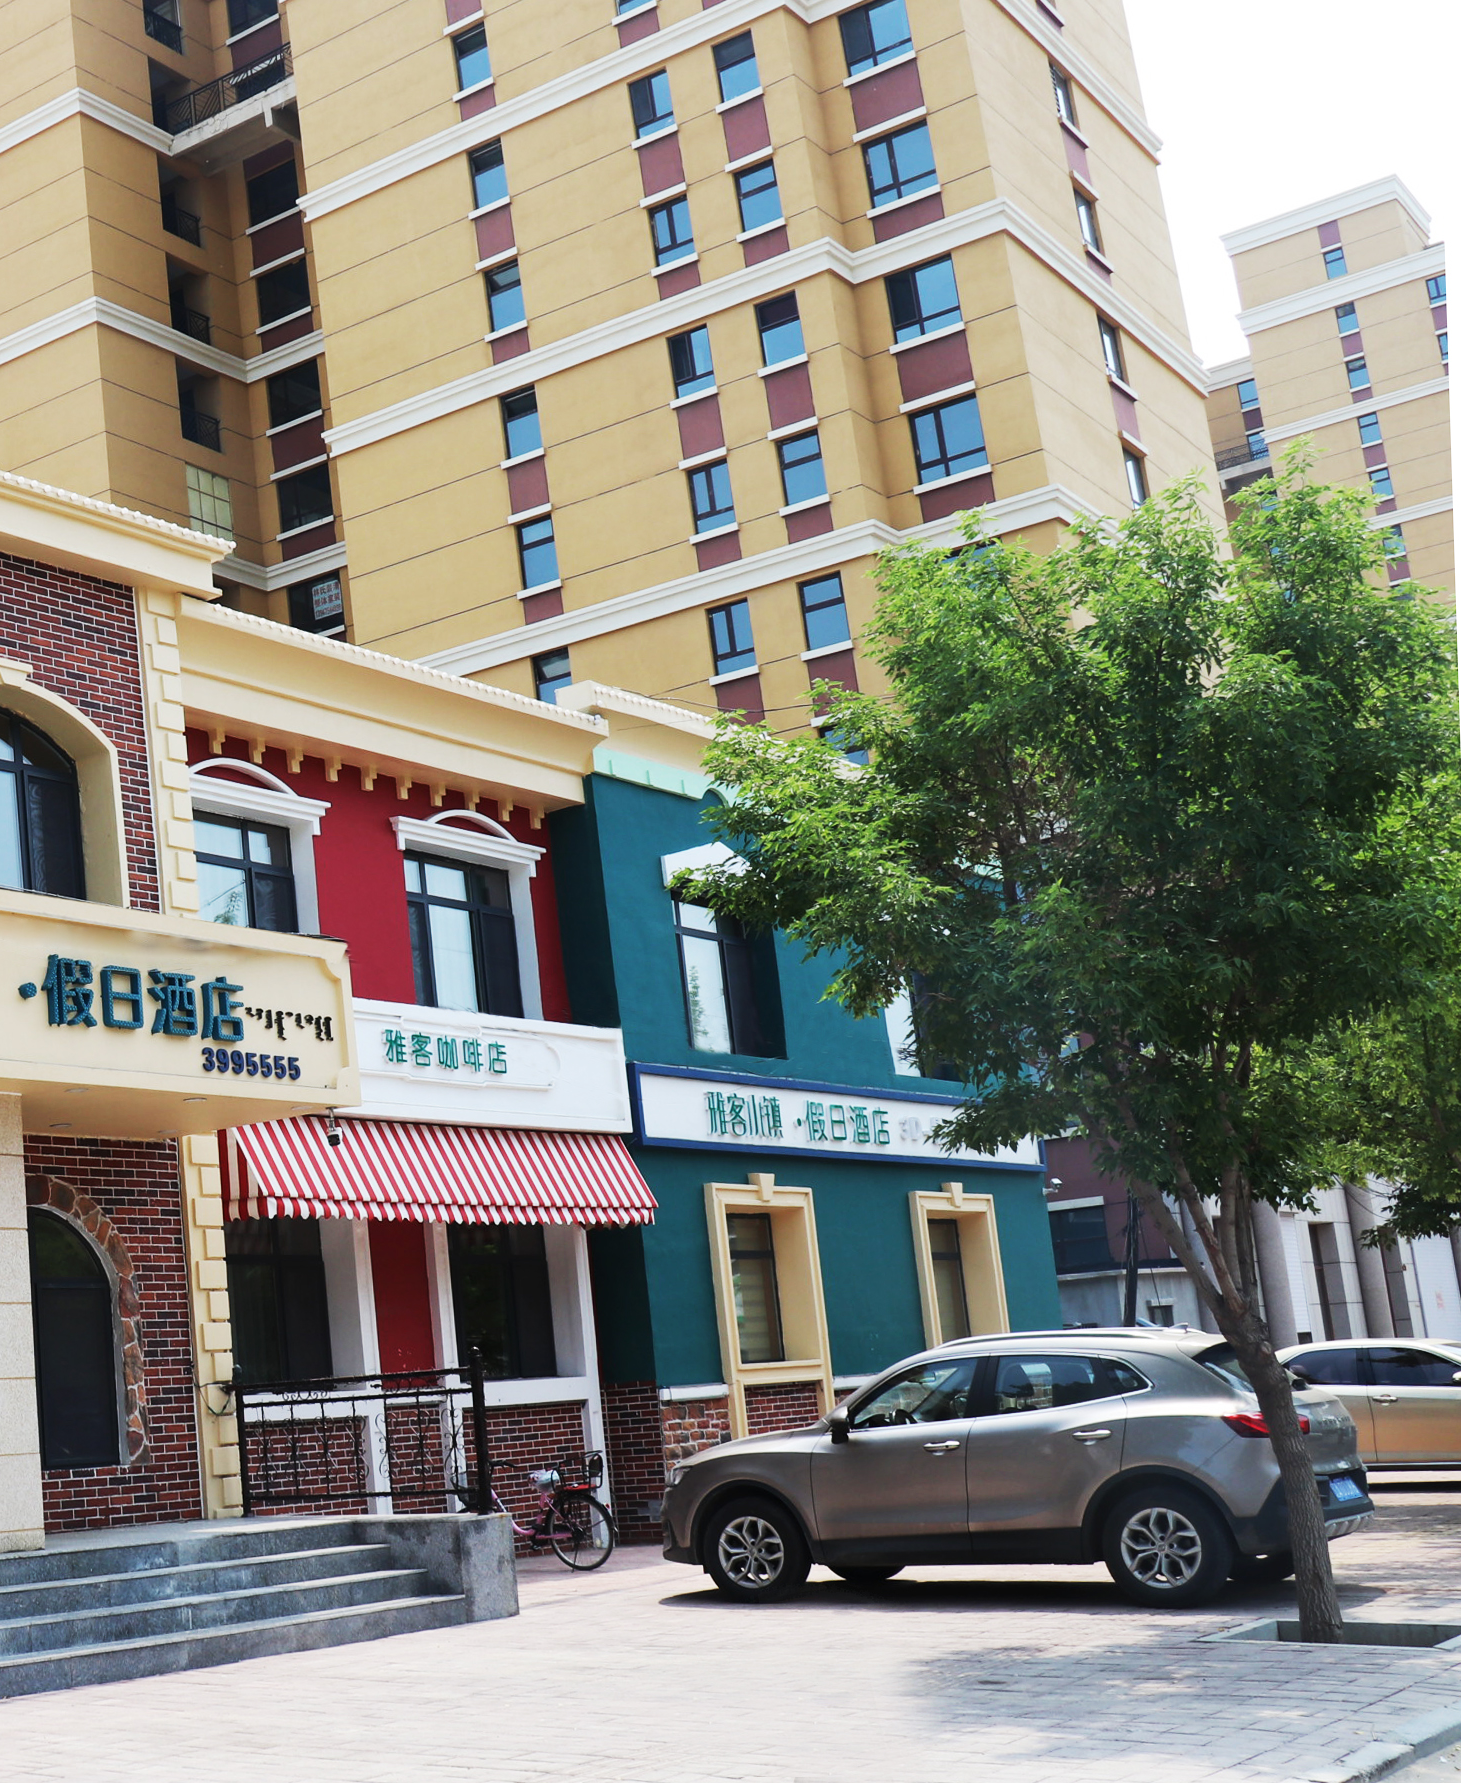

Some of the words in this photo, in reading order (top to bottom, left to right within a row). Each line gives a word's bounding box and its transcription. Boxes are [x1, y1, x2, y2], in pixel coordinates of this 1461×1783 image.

[201, 1047, 301, 1081] 3995555
[382, 1028, 508, 1076] 雅客咖啡店
[705, 1091, 784, 1138] 雅客小镇
